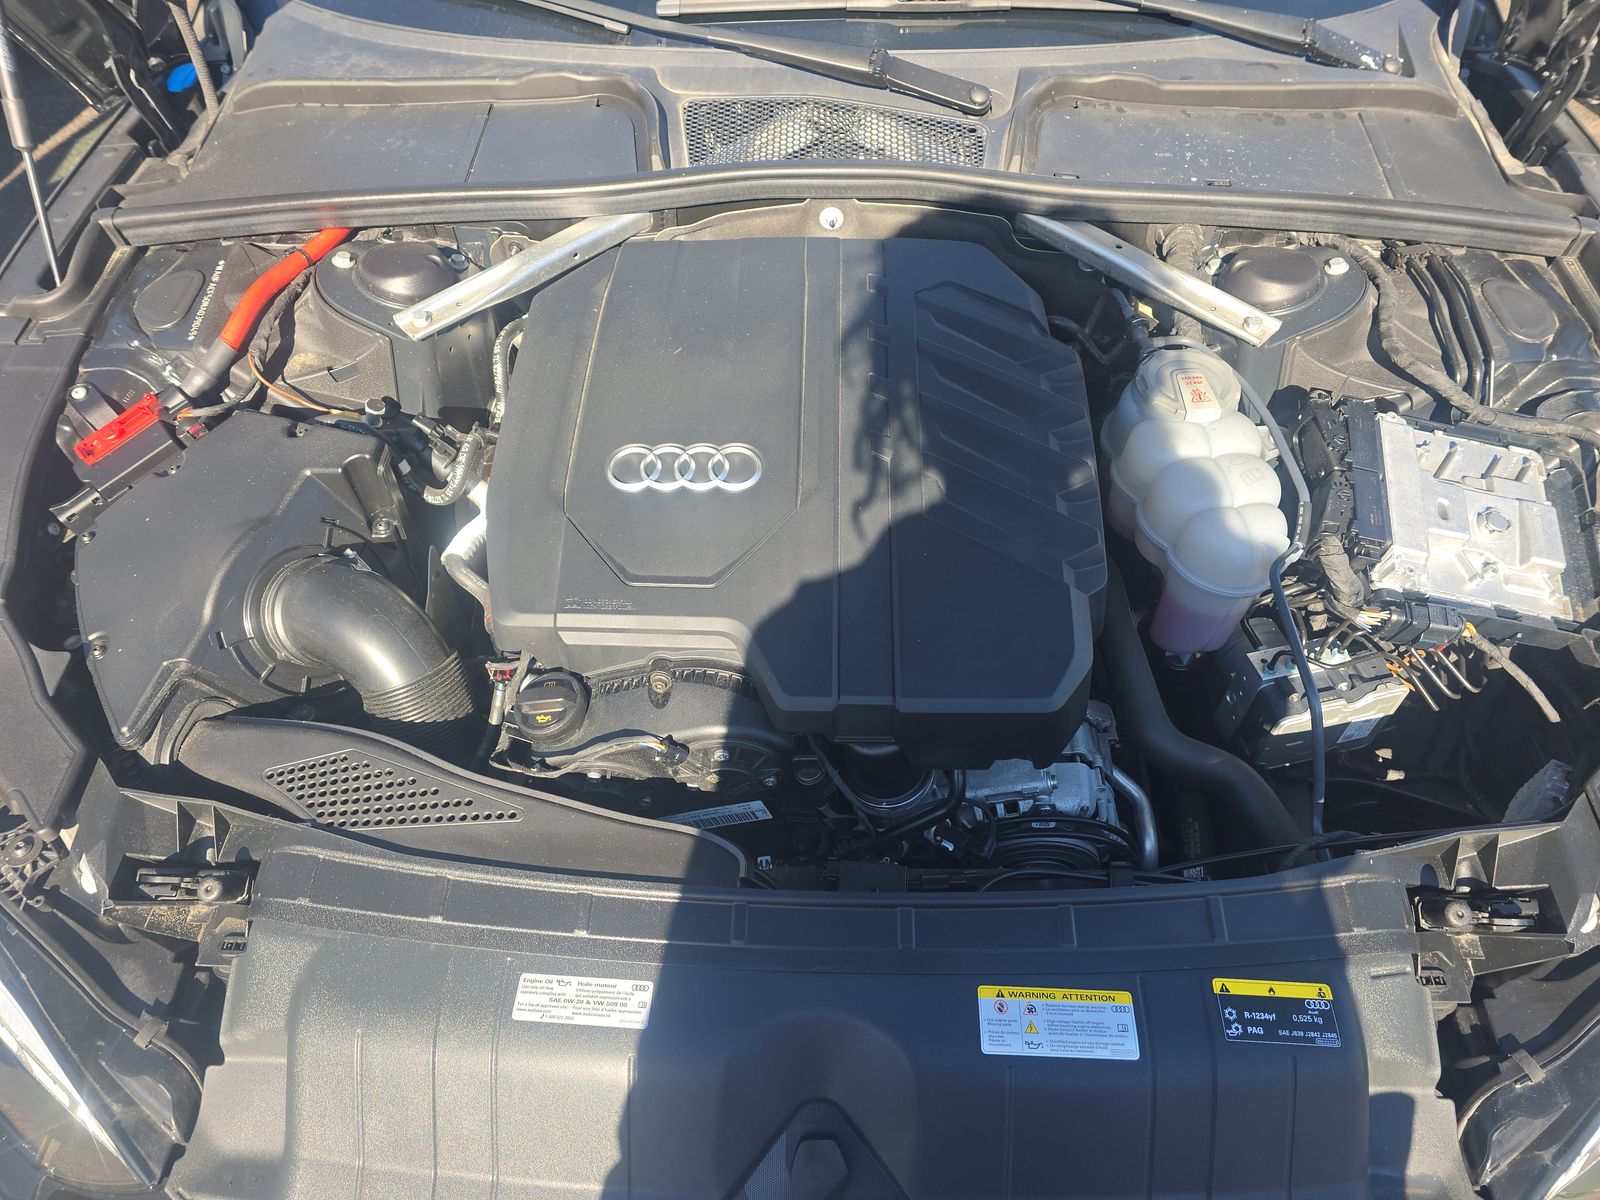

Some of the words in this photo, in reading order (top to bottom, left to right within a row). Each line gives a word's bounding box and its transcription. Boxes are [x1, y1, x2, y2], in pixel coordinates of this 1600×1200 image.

[1008, 990, 1056, 1000] WARNING
[1062, 993, 1116, 1002] ATTENTION
[1244, 1011, 1277, 1021] R-1234yf
[1292, 1014, 1313, 1023] 0,525
[1313, 1016, 1324, 1025] kg
[1247, 1026, 1265, 1035] PAG
